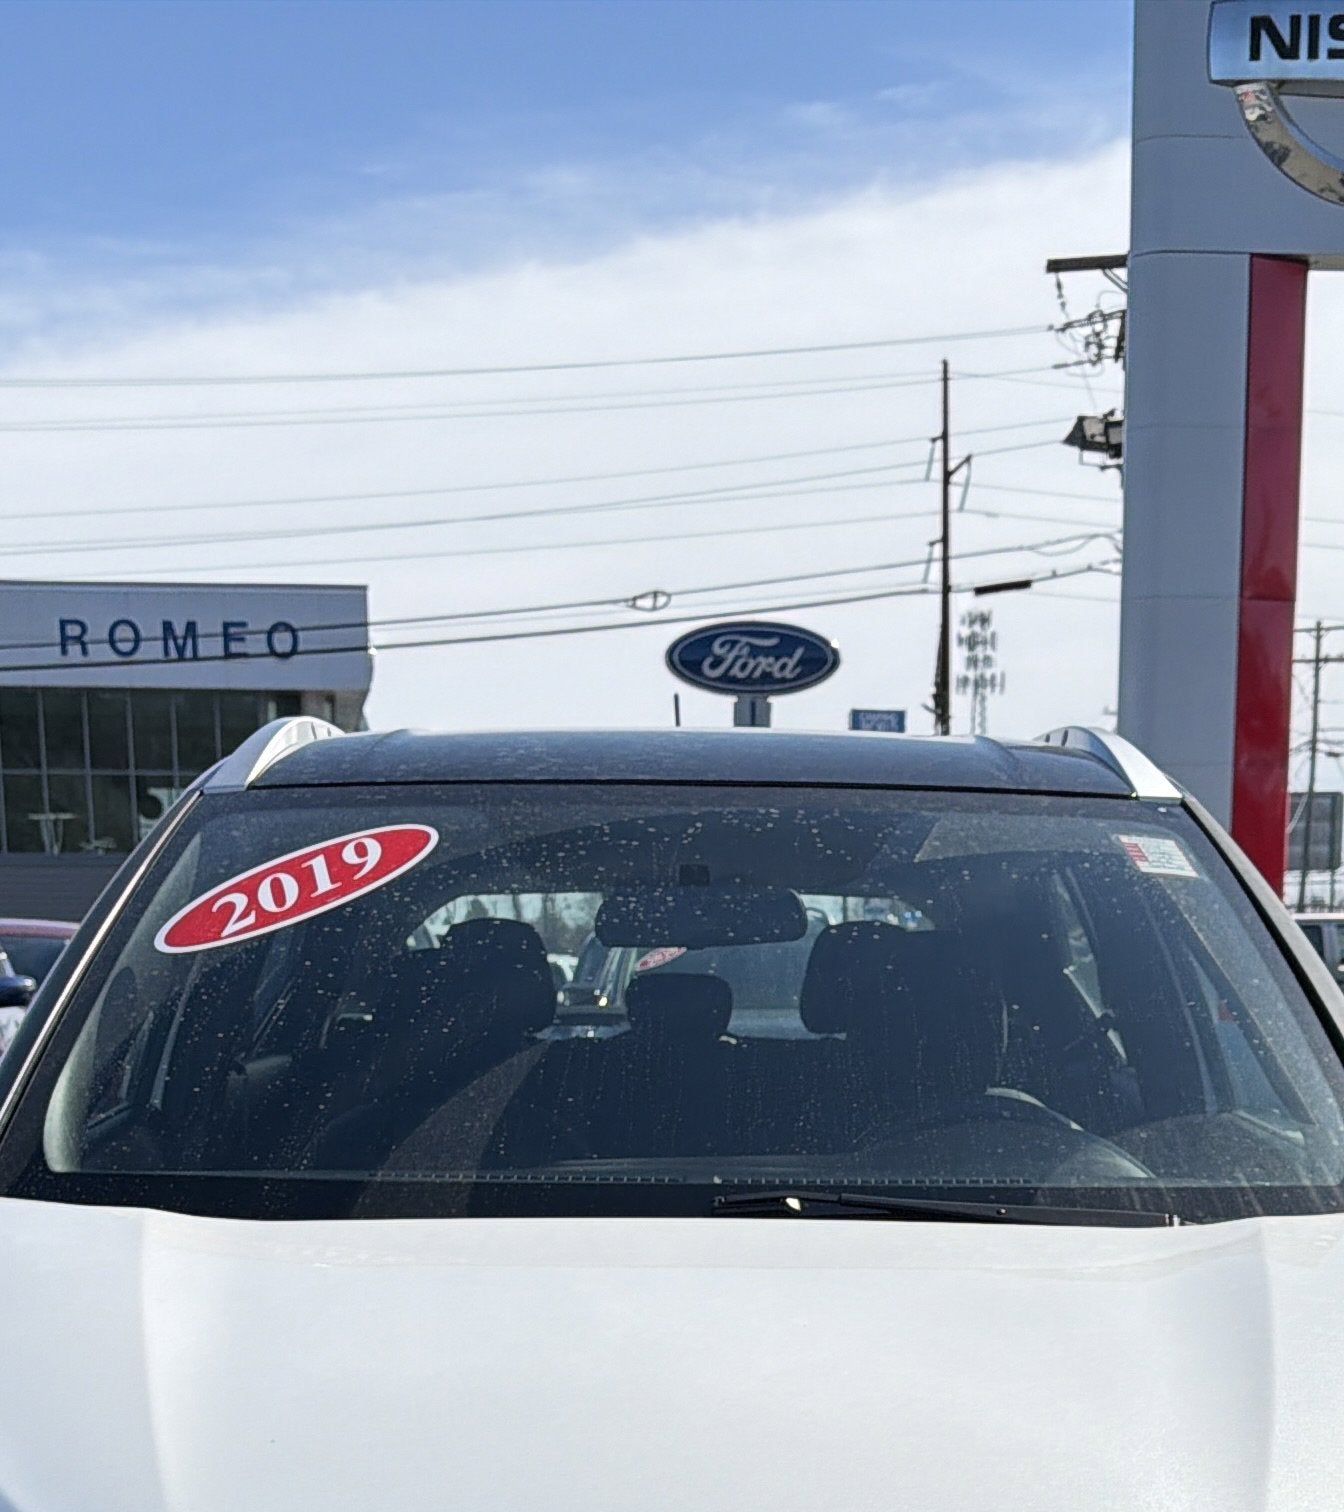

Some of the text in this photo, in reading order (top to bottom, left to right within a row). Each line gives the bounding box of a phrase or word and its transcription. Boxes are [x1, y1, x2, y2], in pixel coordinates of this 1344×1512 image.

[59, 619, 299, 659] ROMEO
[701, 634, 805, 679] Ford
[211, 837, 382, 937] 2019
